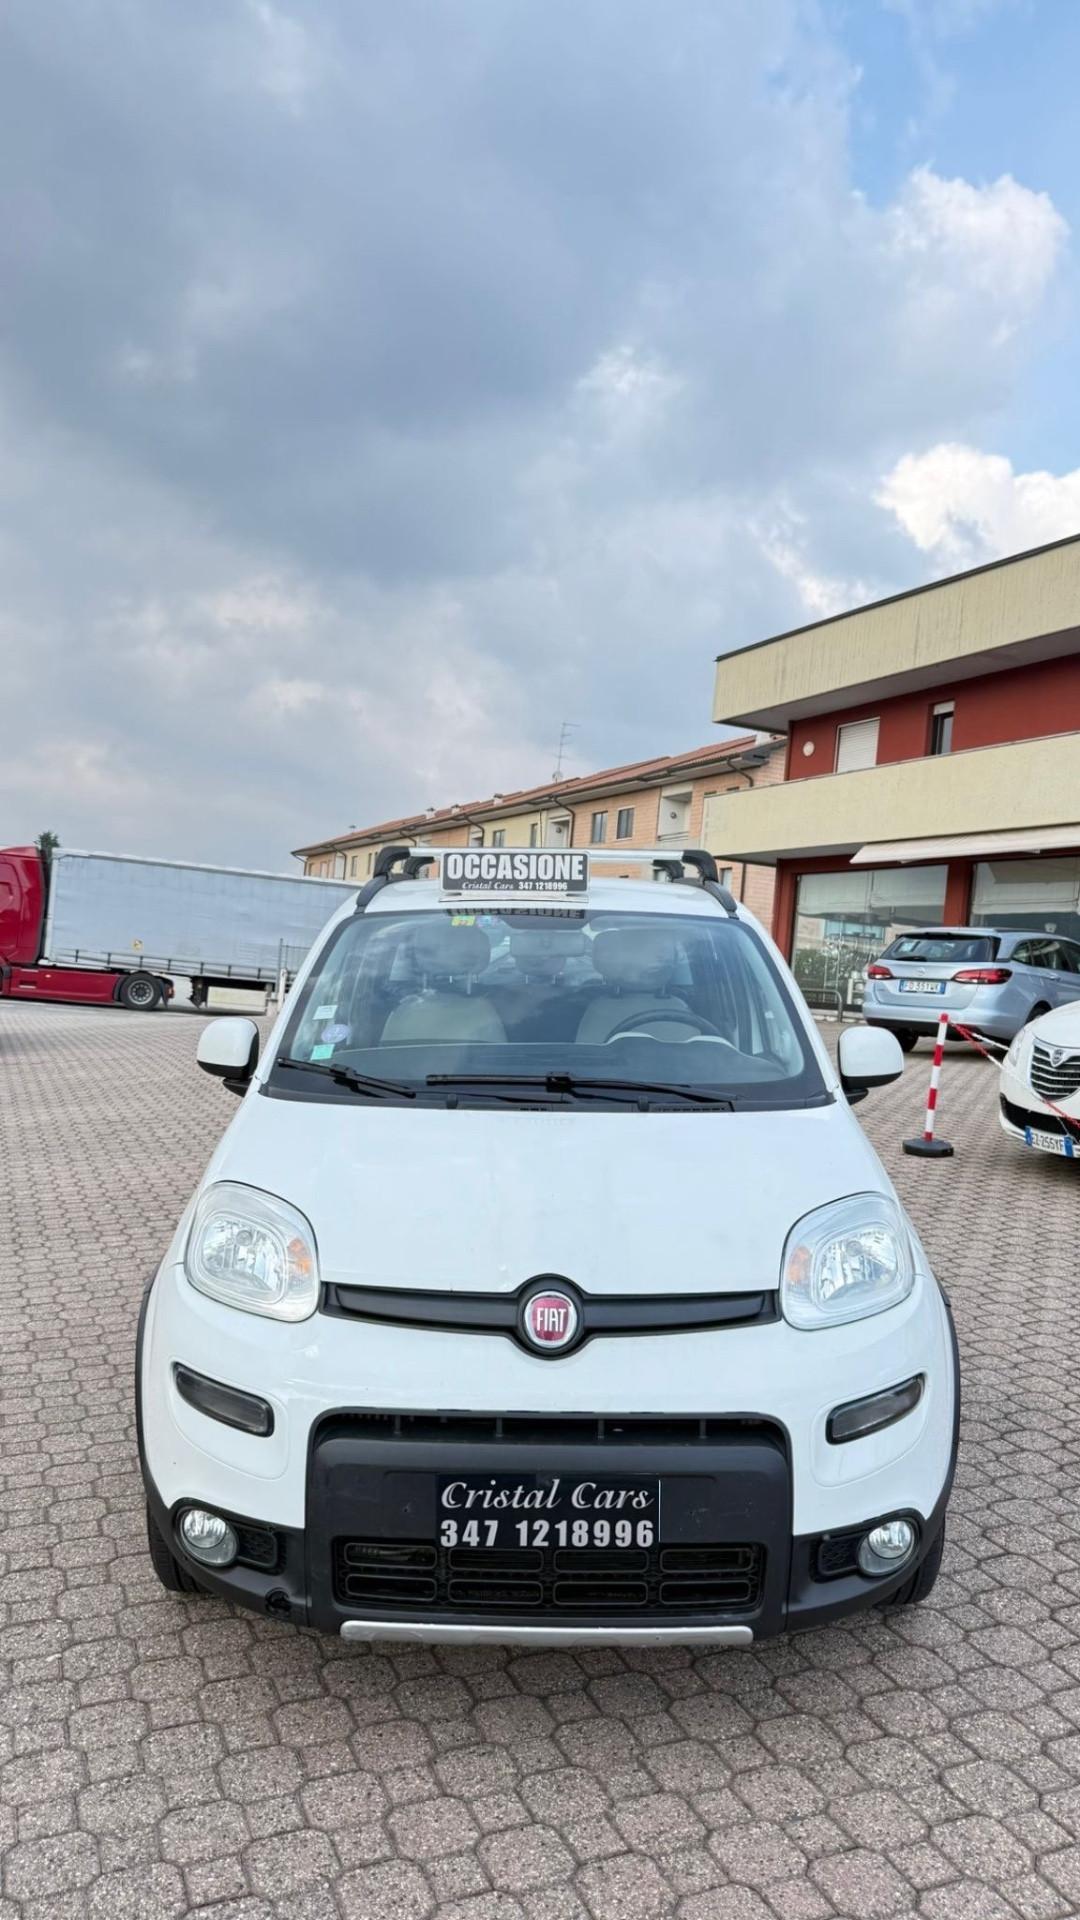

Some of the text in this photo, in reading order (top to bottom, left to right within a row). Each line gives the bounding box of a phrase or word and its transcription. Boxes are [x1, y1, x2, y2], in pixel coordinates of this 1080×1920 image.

[447, 854, 584, 880] OCCASIONE
[462, 881, 568, 891] Cristal Cars 347 1218996
[536, 1307, 567, 1333] FIAT
[441, 1478, 655, 1510] Cristal Cars
[440, 1519, 654, 1548] 347 1218996
